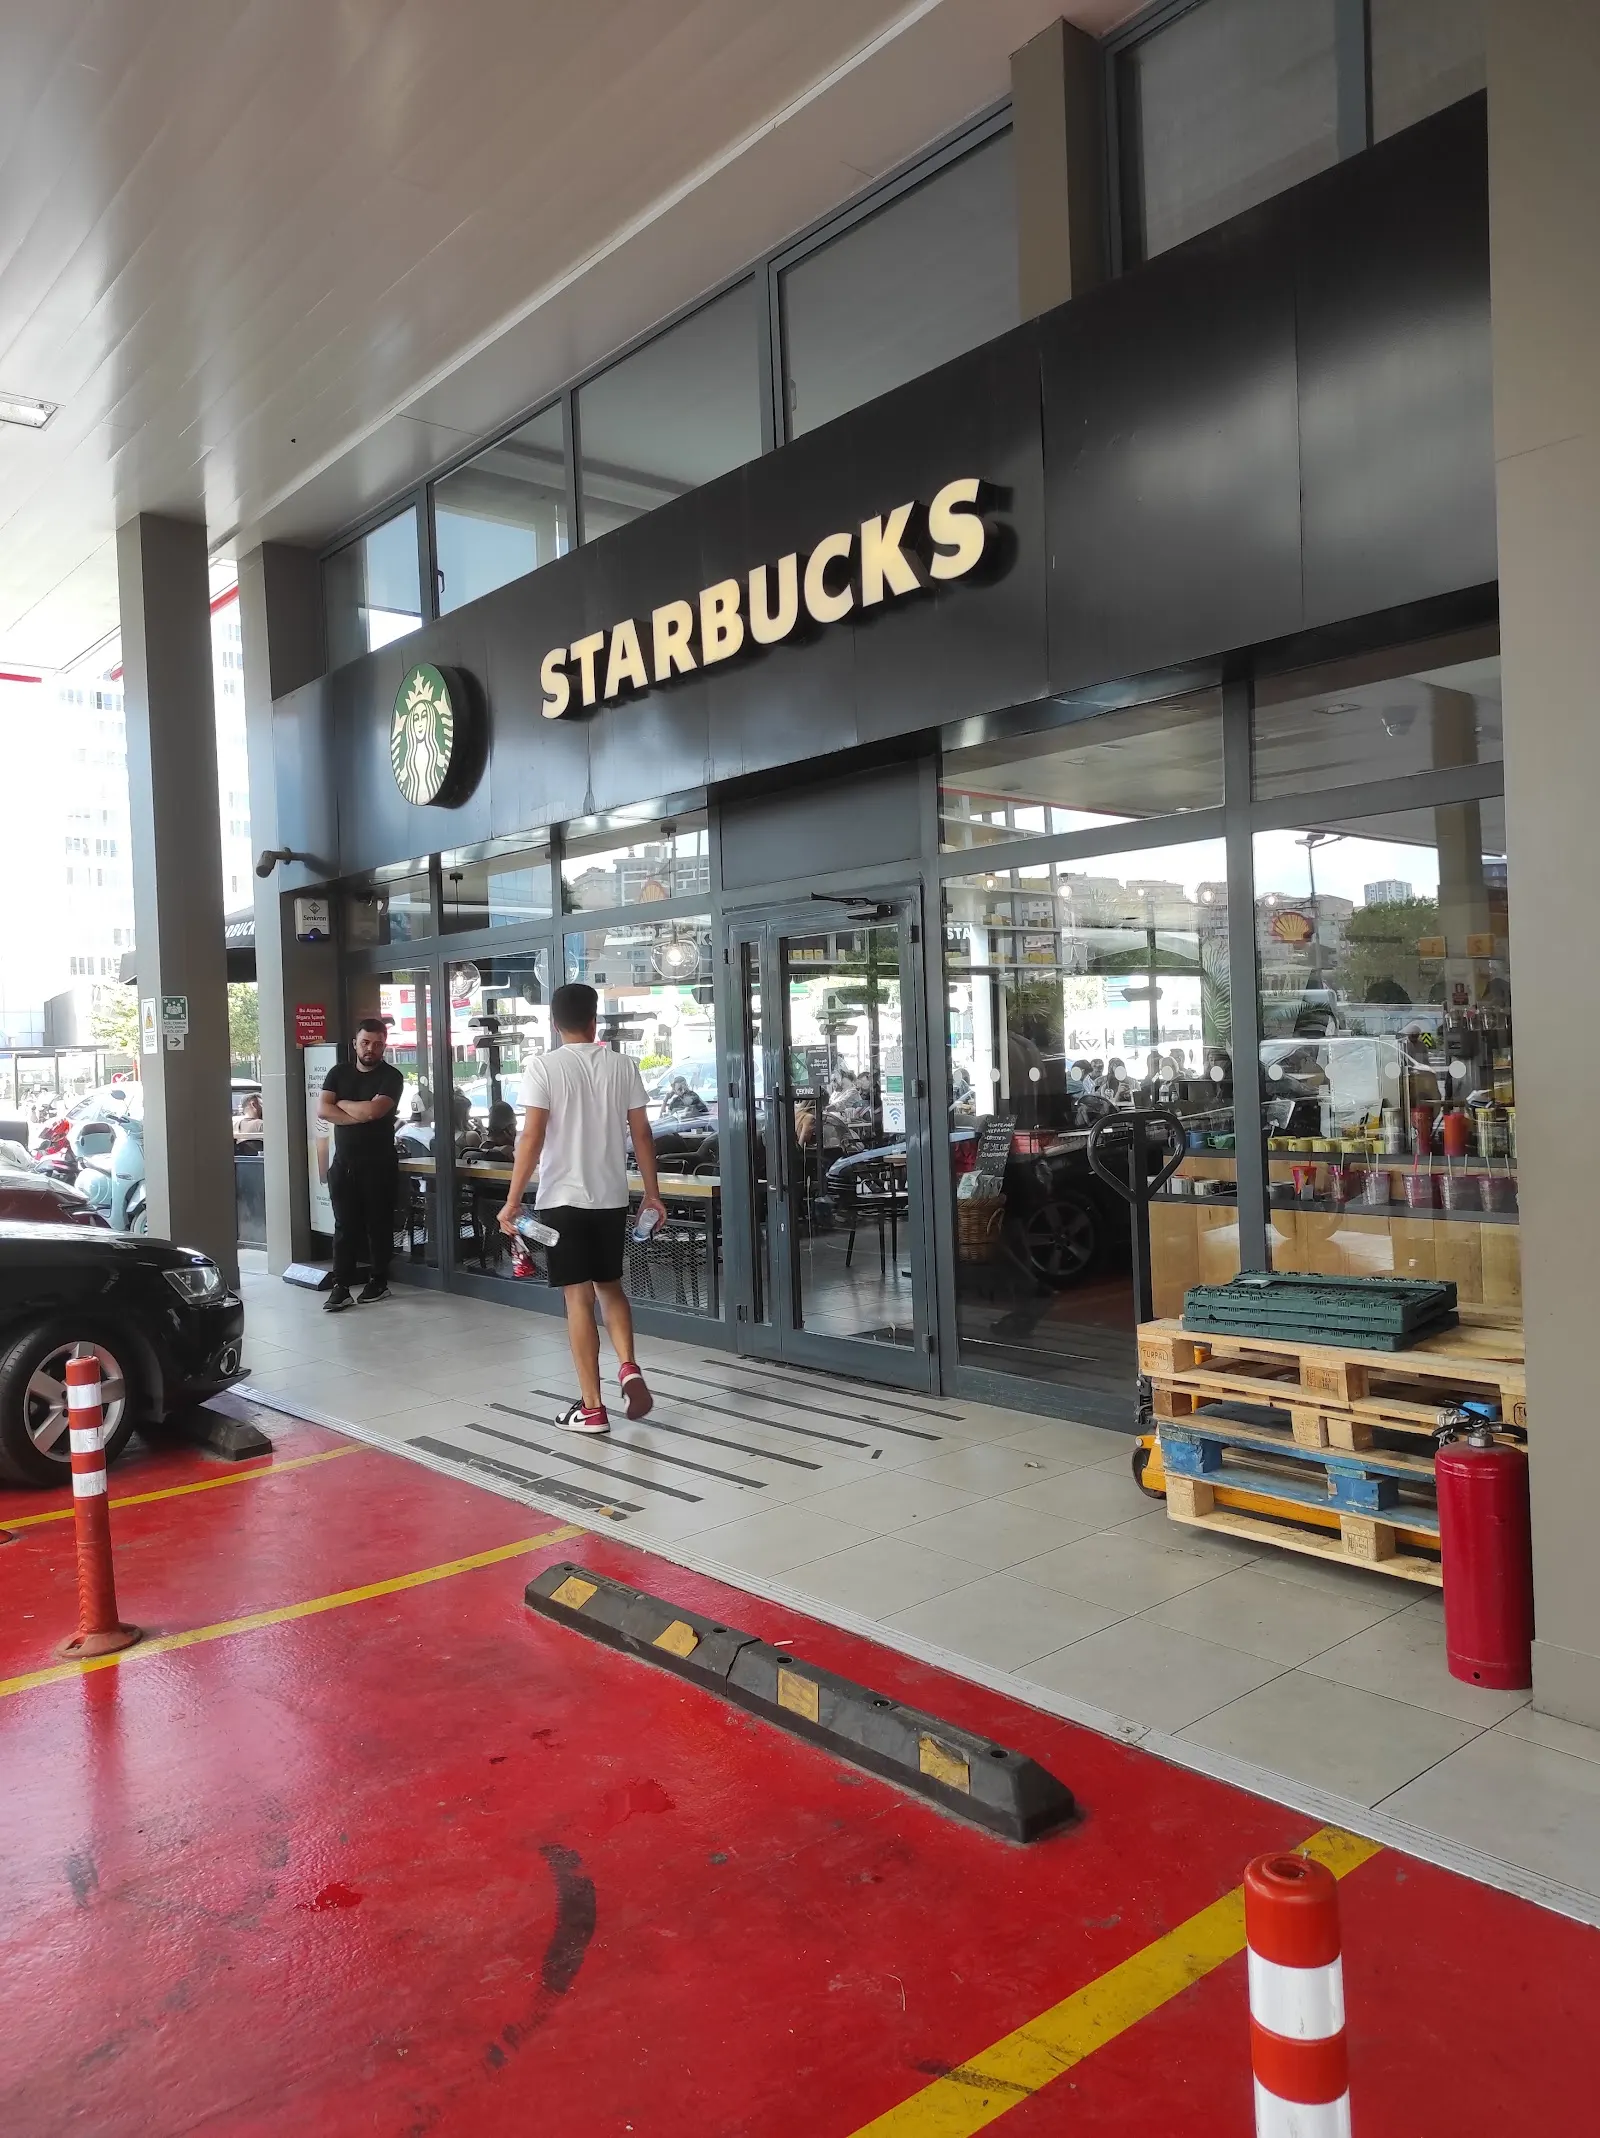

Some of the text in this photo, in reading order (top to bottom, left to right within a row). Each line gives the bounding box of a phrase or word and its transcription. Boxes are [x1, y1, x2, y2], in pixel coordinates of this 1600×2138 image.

[540, 478, 985, 719] STARBUCKS
[795, 1086, 815, 1097] ÇEKİNİZ
[1143, 1349, 1167, 1360] TURPAL
